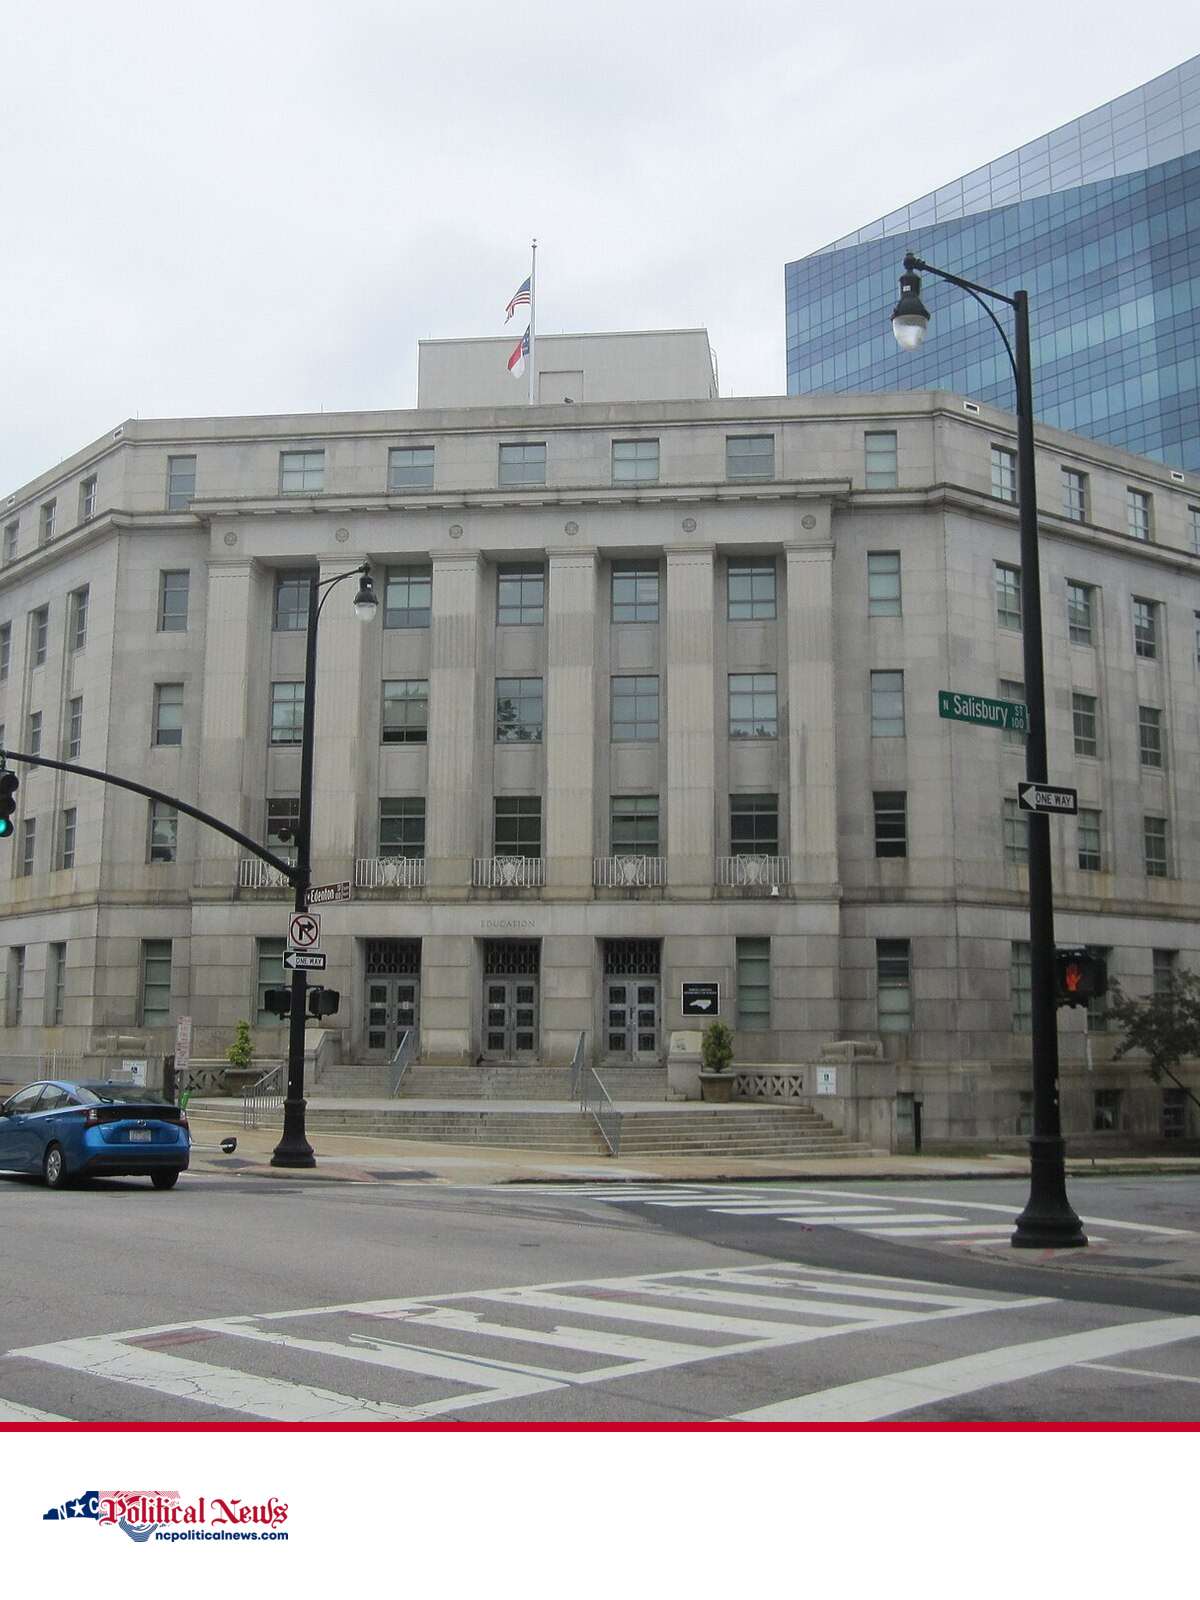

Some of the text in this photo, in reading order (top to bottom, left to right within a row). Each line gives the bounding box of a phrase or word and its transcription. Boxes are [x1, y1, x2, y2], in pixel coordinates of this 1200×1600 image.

[943, 695, 1023, 727] N Salisbury ST
[1011, 718, 1024, 729] 100
[1035, 793, 1072, 806] ONE WAY
[480, 919, 536, 928] EDUCATION
[295, 957, 322, 966] ONE WAY
